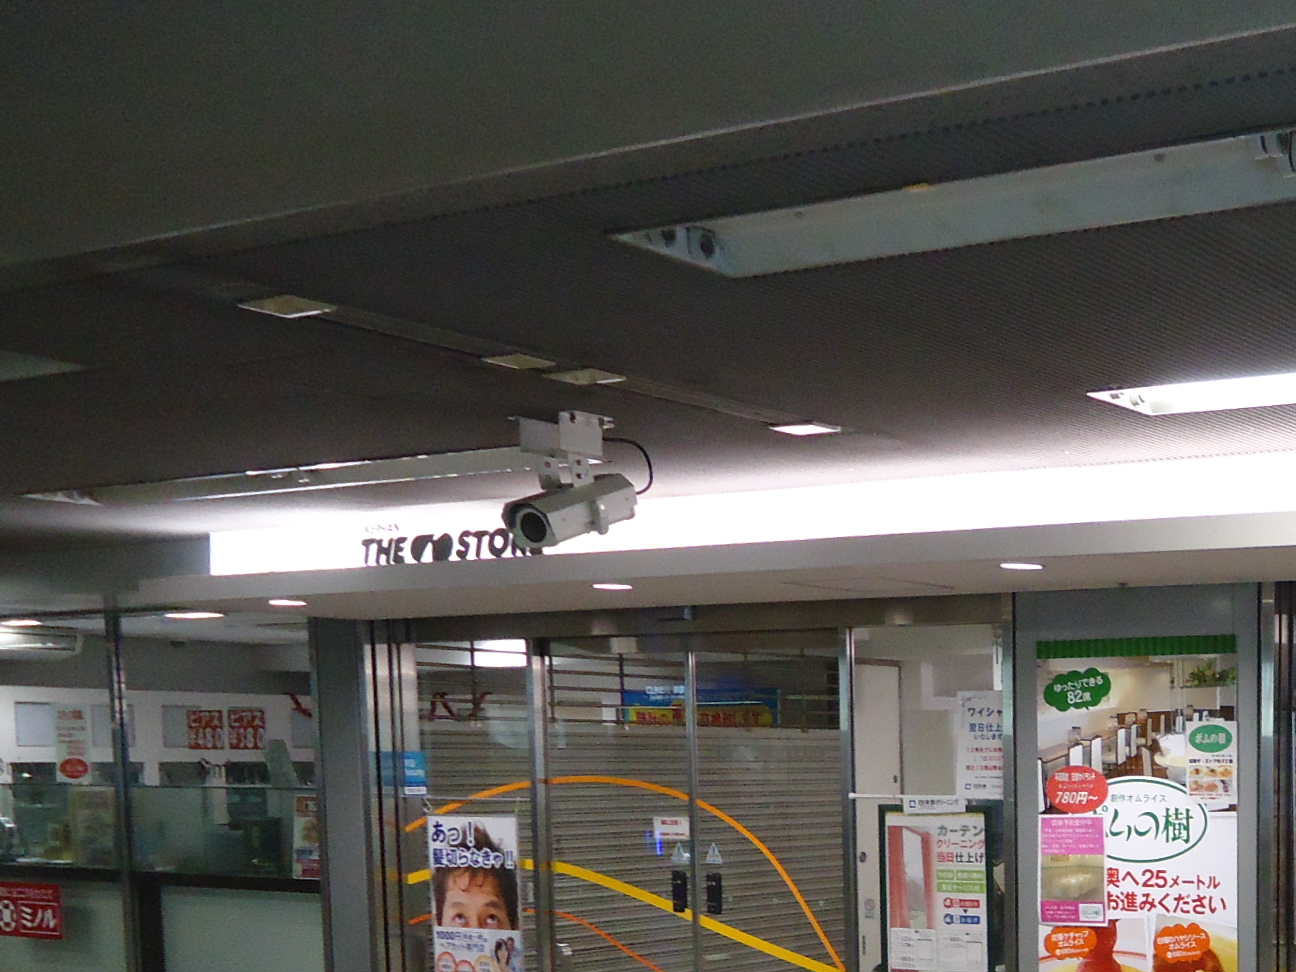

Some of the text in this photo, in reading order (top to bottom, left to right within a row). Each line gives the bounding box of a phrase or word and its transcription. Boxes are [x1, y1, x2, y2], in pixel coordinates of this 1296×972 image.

[362, 527, 543, 567] THE STO
[1053, 676, 1104, 693] ゆったりできる
[187, 711, 222, 727] ピアス
[229, 711, 264, 727] ピアス
[1110, 793, 1168, 803] 創作オムライス
[937, 824, 985, 837] カーテン
[937, 839, 985, 850] クリーニング
[937, 851, 985, 864] 当日仕上げ
[1106, 867, 1221, 891] 奥へ25メートル
[1107, 891, 1227, 915] お進みください
